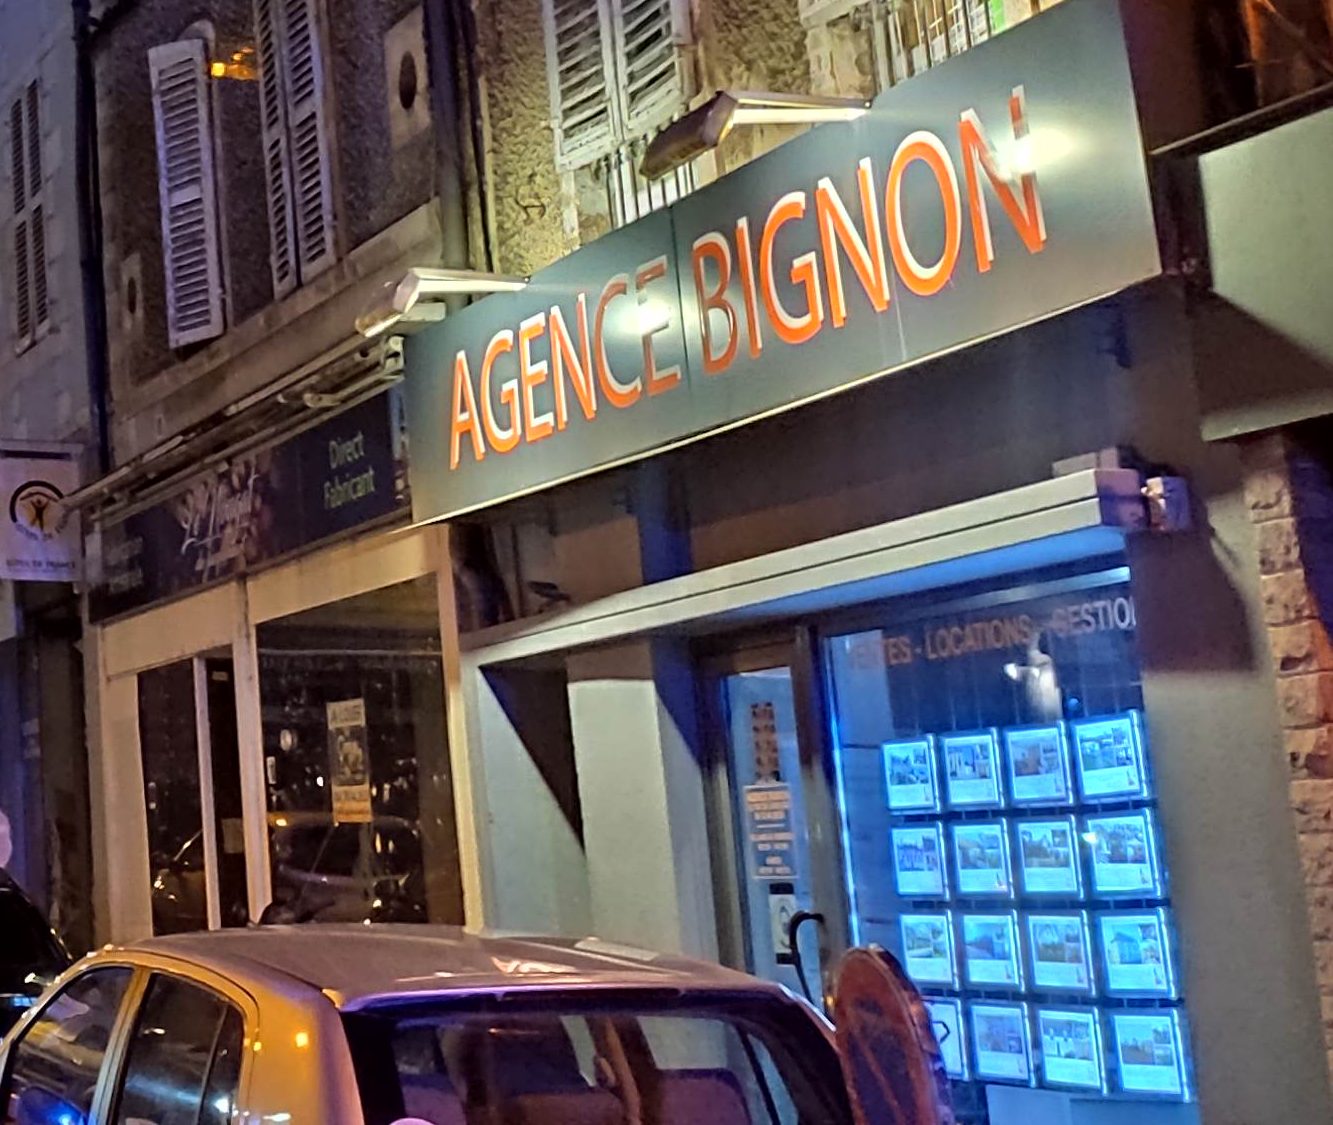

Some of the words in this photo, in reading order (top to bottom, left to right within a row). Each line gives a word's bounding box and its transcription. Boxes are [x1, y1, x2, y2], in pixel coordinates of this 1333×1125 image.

[449, 255, 682, 471] AGENCE
[690, 85, 1048, 376] BIGNON
[329, 431, 365, 470] Direct
[323, 465, 376, 510] Fabricant
[924, 614, 1033, 659] LOCATIONS
